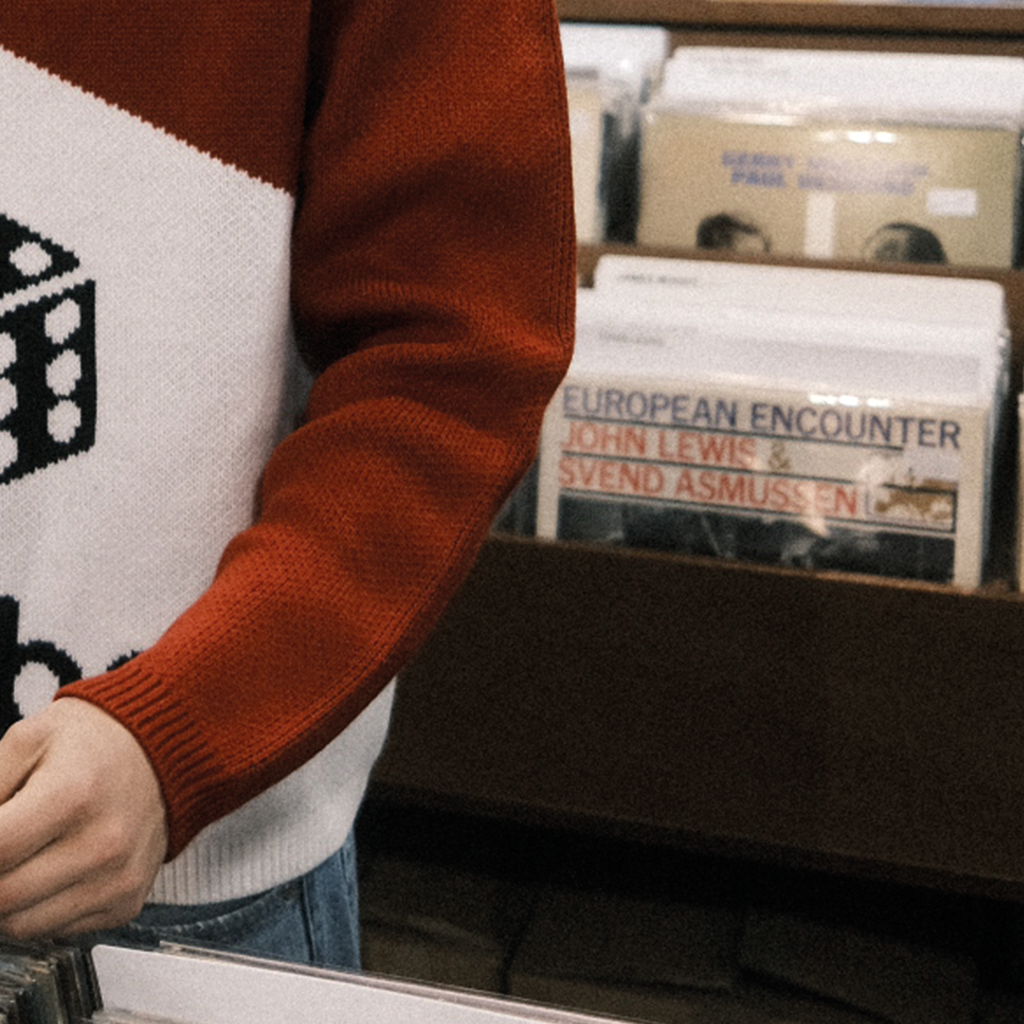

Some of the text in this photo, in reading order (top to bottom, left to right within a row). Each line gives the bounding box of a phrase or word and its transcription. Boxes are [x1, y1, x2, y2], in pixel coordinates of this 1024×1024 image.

[560, 421, 790, 471] JOHN LEWIS &
[563, 386, 961, 449] EUROPEAN ENCOUNTER
[558, 456, 858, 517] SVEND ASMUSSEN
